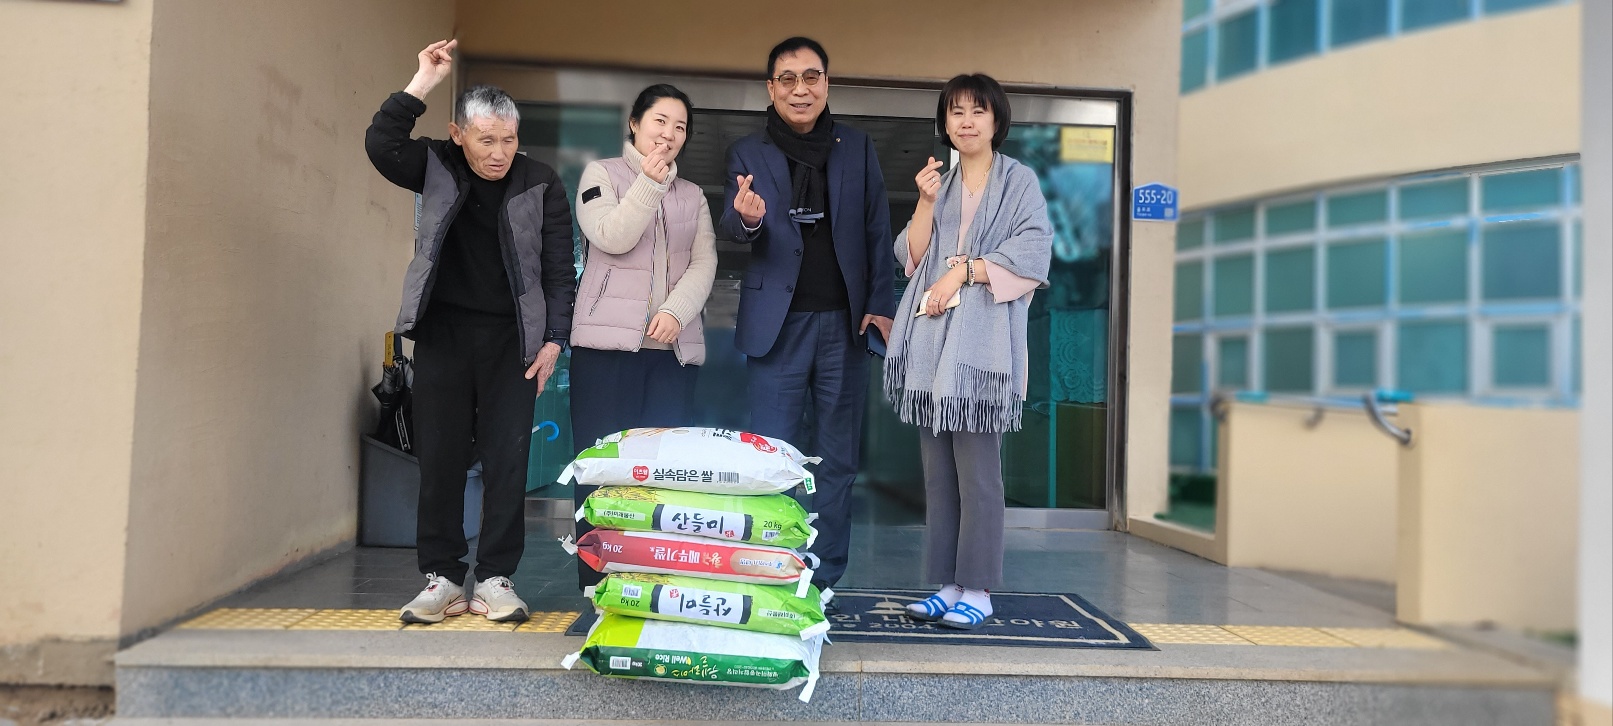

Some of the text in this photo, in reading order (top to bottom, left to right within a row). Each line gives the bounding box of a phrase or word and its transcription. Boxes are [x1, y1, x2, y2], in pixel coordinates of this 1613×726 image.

[1138, 189, 1173, 205] 555-20
[652, 468, 714, 483] 실속담은 쌀
[671, 512, 724, 535] 산들미
[763, 520, 782, 530] 20 kg
[602, 541, 624, 553] 20 kg
[654, 546, 700, 564] 메뚜기쌀
[620, 597, 640, 607] 20 kg
[679, 593, 732, 617] 산들미
[655, 653, 688, 665] Well Rice
[671, 655, 719, 679] 웰라이스
